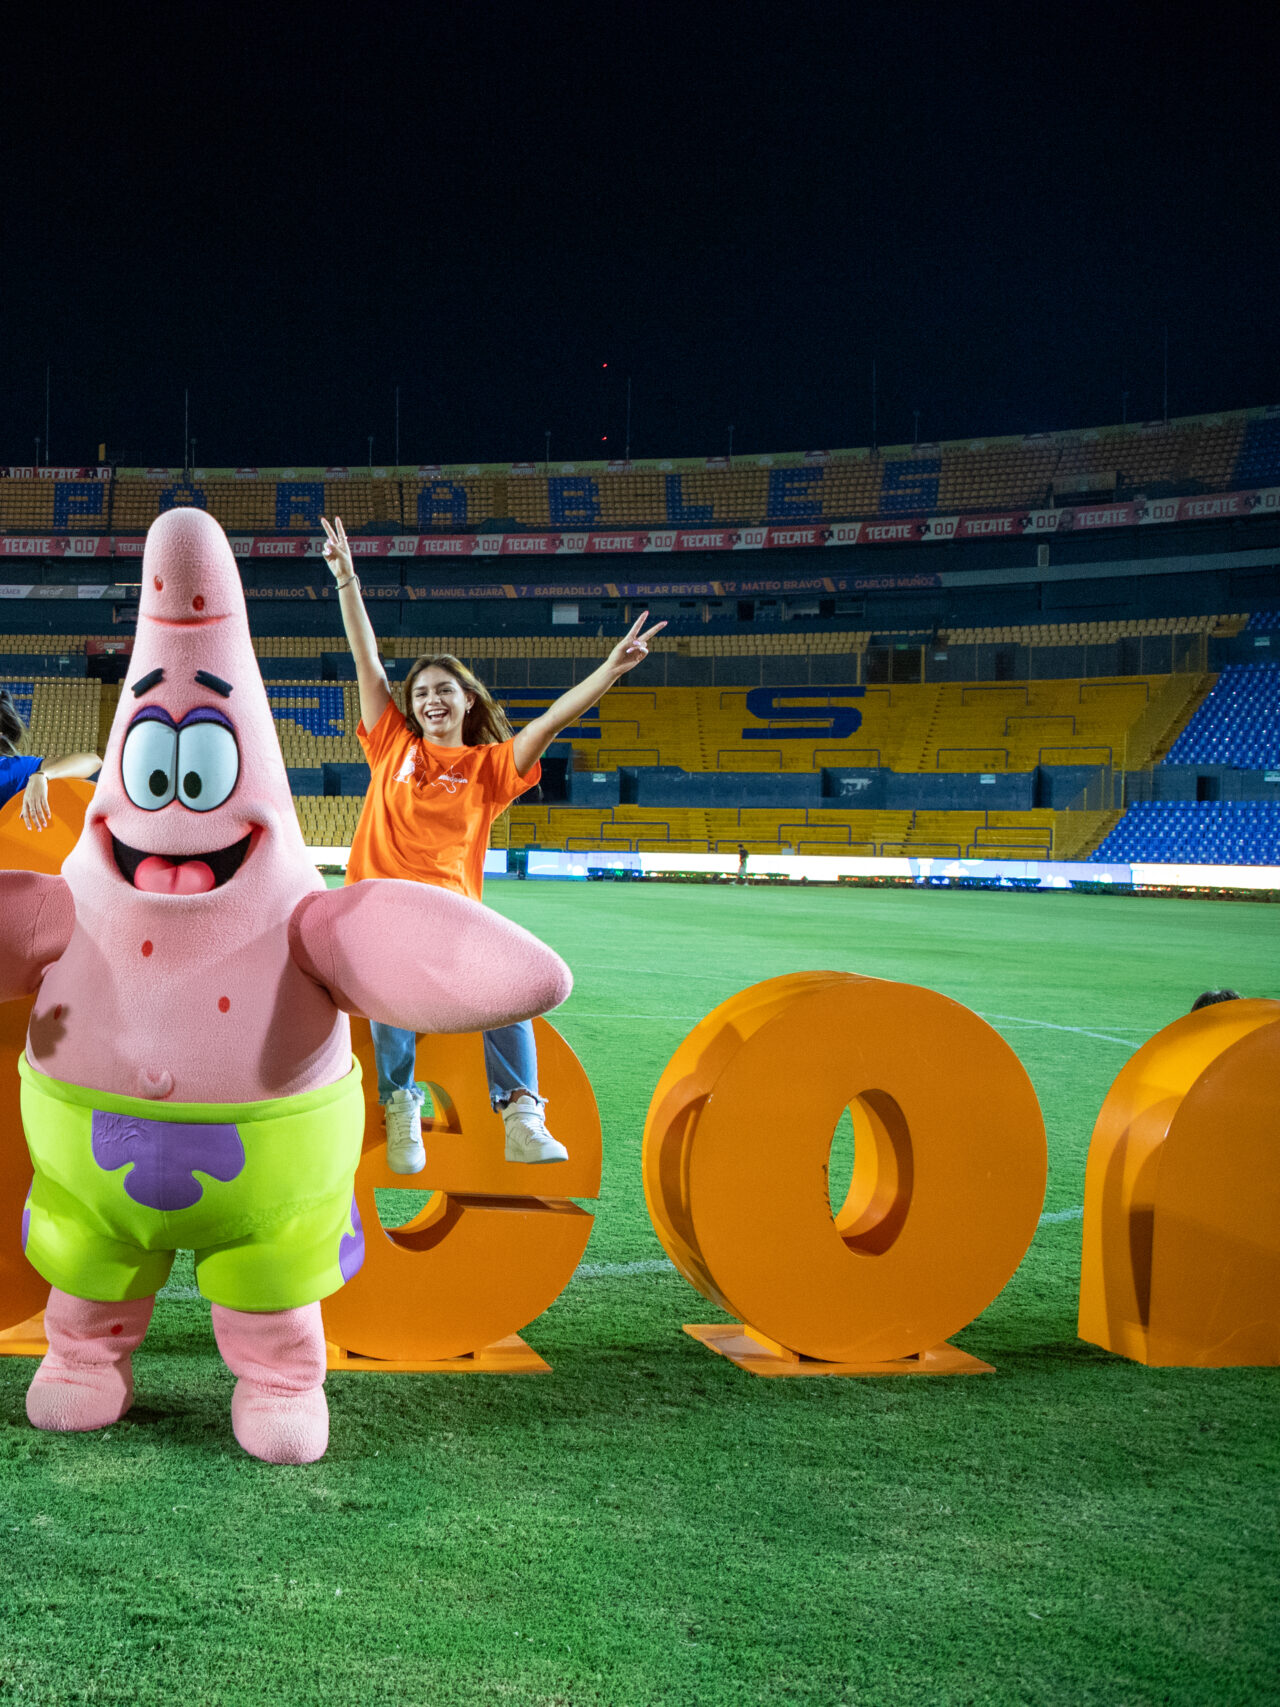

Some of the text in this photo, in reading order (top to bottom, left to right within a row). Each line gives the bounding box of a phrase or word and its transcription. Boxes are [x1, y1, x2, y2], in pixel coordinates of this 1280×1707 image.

[38, 467, 79, 478] TECATE
[3, 538, 51, 553] TECATE
[258, 542, 296, 554] TECATE
[348, 541, 379, 553] ECATE
[423, 539, 461, 551] TECATE
[506, 538, 548, 550] TECATE
[592, 537, 635, 549] TECATE
[680, 533, 724, 547] TECATE
[771, 531, 815, 544] TECATE
[866, 526, 912, 540] TECATE
[964, 518, 1014, 534] TECATE
[1078, 510, 1129, 526] TECATE
[1184, 497, 1240, 516] TECATE
[724, 580, 820, 591] 12 MATEO BRAVO
[855, 579, 894, 589] CARLOS
[897, 575, 935, 587] MUÑOZ
[243, 589, 273, 597] ARLOS
[378, 589, 399, 597] BOY
[431, 589, 466, 597] MANUEL
[468, 589, 504, 597] AZUARA
[534, 586, 602, 596] BARBADILLO
[637, 586, 668, 594] PILAR
[672, 585, 708, 594] REYES
